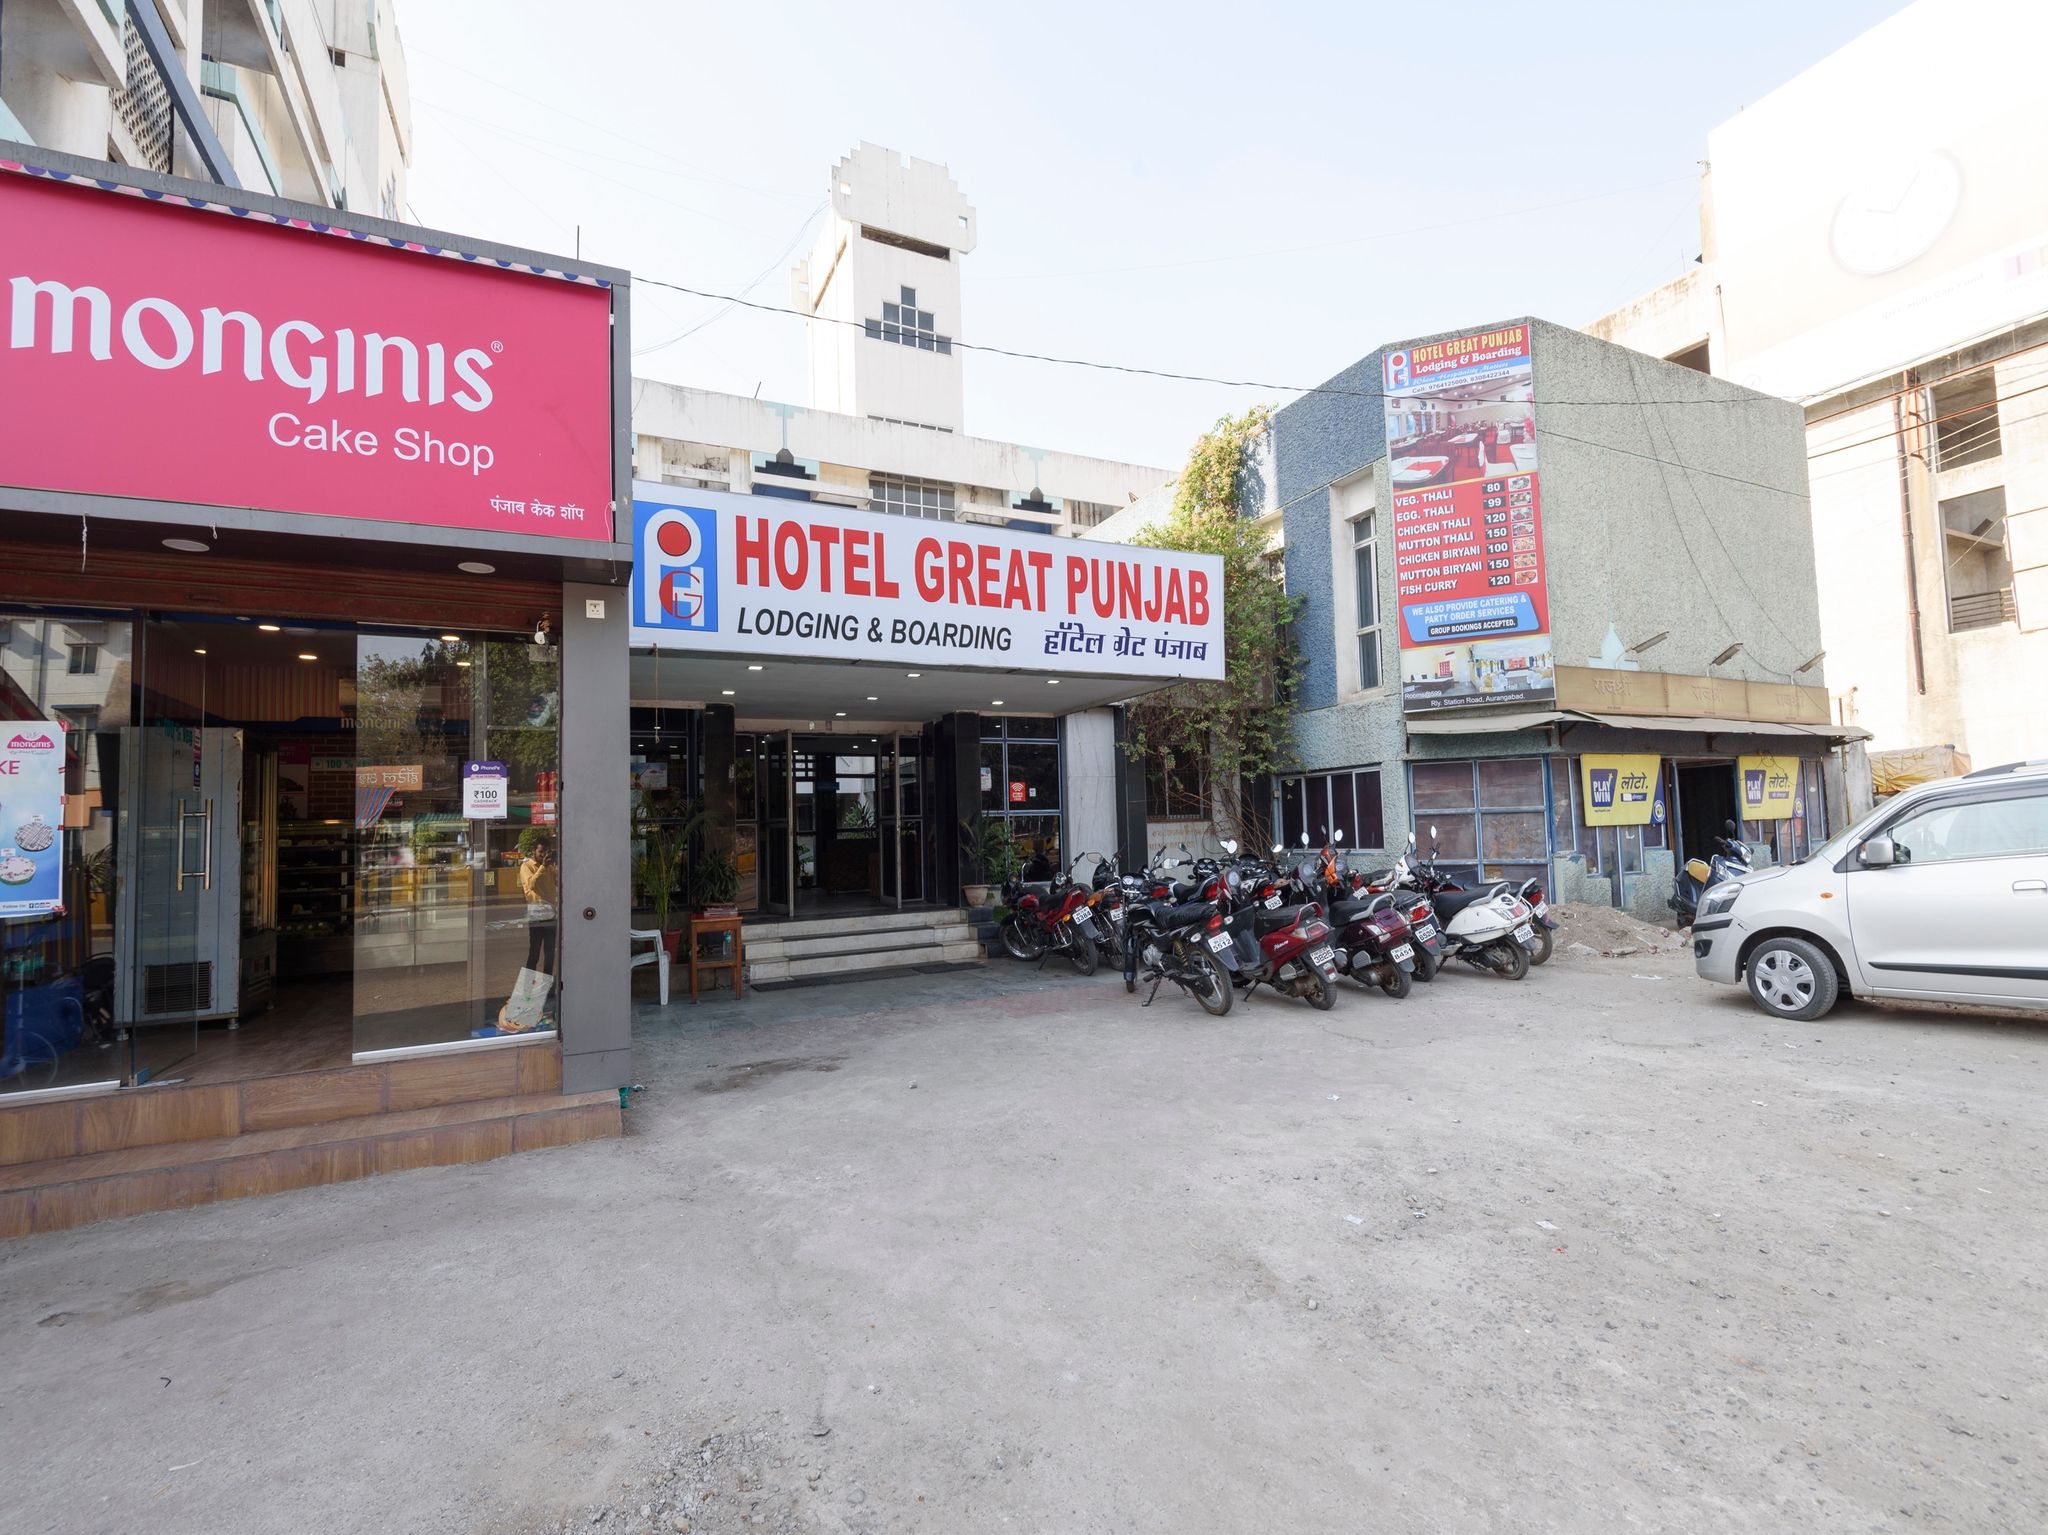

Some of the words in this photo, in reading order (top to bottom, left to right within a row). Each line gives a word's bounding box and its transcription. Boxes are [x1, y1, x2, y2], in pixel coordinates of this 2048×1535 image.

[1413, 344, 1443, 364] HOTEL
[1446, 337, 1478, 355] GREAT
[1481, 328, 1522, 348] PUNJAB
[1415, 356, 1457, 374] Lodging
[1460, 355, 1470, 364] &
[1472, 346, 1521, 363] Boarding
[268, 412, 379, 456] Cake
[394, 427, 495, 475] Shop
[1487, 482, 1500, 492] 80
[1395, 496, 1419, 507] VEG.
[1422, 489, 1453, 504] THALI
[1488, 498, 1501, 507] 99
[490, 495, 526, 515] पंजाब
[530, 499, 556, 518] केक
[559, 503, 585, 521] शॉप
[1397, 511, 1421, 522] EGG.
[1424, 504, 1454, 519] THALI
[1486, 513, 1506, 523] 120
[1397, 520, 1440, 537] CHICKEN
[1442, 517, 1471, 530] THALI
[1487, 528, 1507, 538] 150
[1398, 535, 1441, 551] MUTTON
[1443, 531, 1474, 545] THALI
[1488, 542, 1508, 553] 100
[1399, 550, 1441, 566] CHICKEN
[1443, 545, 1480, 559] BIRYANI
[735, 514, 900, 600] HOTEL
[915, 536, 1053, 613] GREAT
[1066, 555, 1210, 626] PUNJAB
[1400, 566, 1441, 581] MUTTON
[1443, 561, 1482, 575] BIRYANI
[1489, 559, 1509, 569] 150
[1400, 584, 1422, 595] FISH
[1424, 580, 1458, 592] CURRY
[1490, 575, 1511, 586] 120
[1412, 607, 1423, 616] WE
[1425, 604, 1445, 615] ALSO
[1446, 600, 1477, 613] PROVIDE
[1480, 596, 1519, 609] CATERING
[1521, 595, 1527, 604] &
[1424, 613, 1448, 624] PARTY
[1450, 610, 1476, 621] ORDER
[1477, 606, 1515, 620] SERVICES
[737, 606, 859, 642] LODGING
[867, 618, 883, 644] &
[890, 620, 1012, 652] BOARDING
[1430, 626, 1451, 635] GROUP
[1451, 622, 1482, 633] BOOKINGS
[1483, 619, 1516, 631] ACCEPTED.
[1044, 621, 1106, 656] हॉटेल
[1113, 627, 1147, 659] ग्रेट
[1154, 631, 1209, 661] पंजाब
[1444, 698, 1465, 706] Station
[1593, 779, 1611, 792] PLAY
[1747, 779, 1761, 791] PLAY
[474, 790, 497, 799] ₹100
[1594, 792, 1611, 803] WIN
[1748, 790, 1761, 800] WIN
[1419, 929, 1435, 941] 8520
[1519, 931, 1533, 942] 7099
[1213, 939, 1231, 951] 5512
[1314, 950, 1333, 964] 3825
[1394, 948, 1412, 960] 8451
